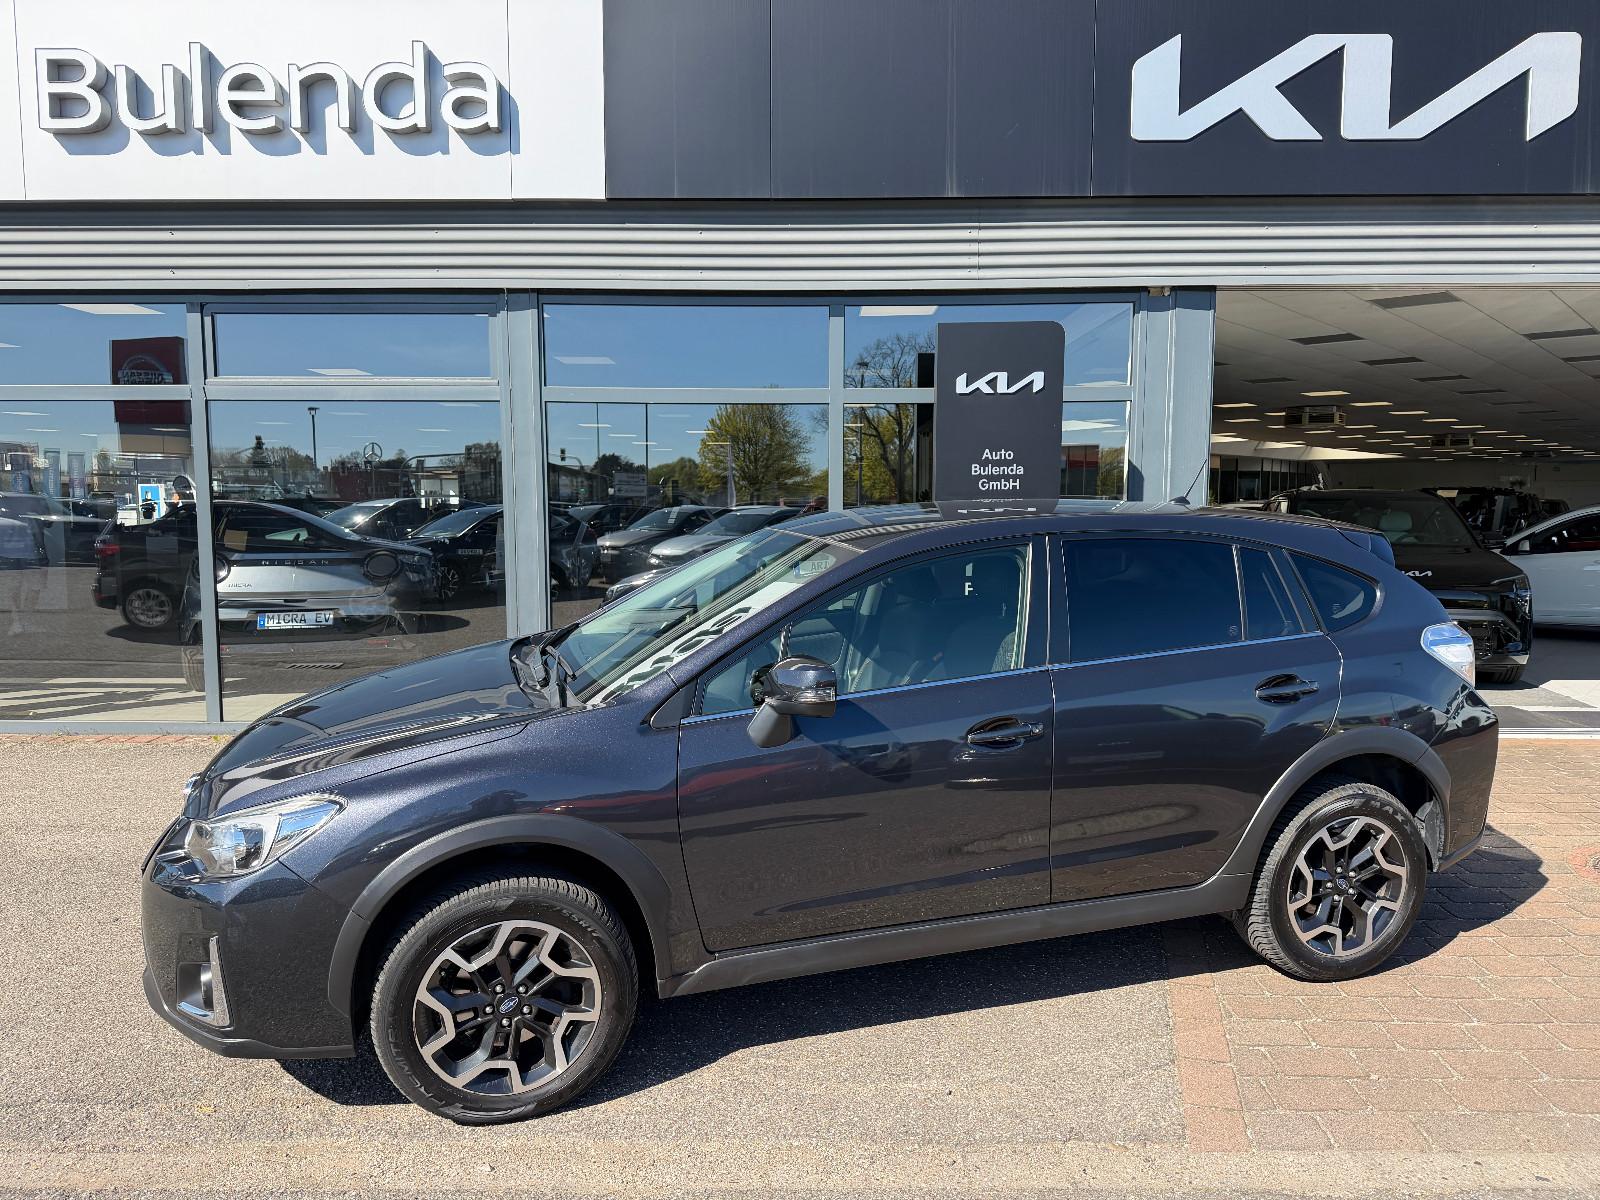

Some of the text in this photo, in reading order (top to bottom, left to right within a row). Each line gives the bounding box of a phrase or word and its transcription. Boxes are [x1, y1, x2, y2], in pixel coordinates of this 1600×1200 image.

[34, 40, 503, 135] Bulenda
[1130, 31, 1583, 142] KIA
[956, 371, 1045, 394] KIA
[982, 449, 1014, 461] Auto
[971, 463, 1025, 476] Bulenda
[978, 478, 1021, 491] GmbH
[266, 612, 332, 625] MICRA EV
